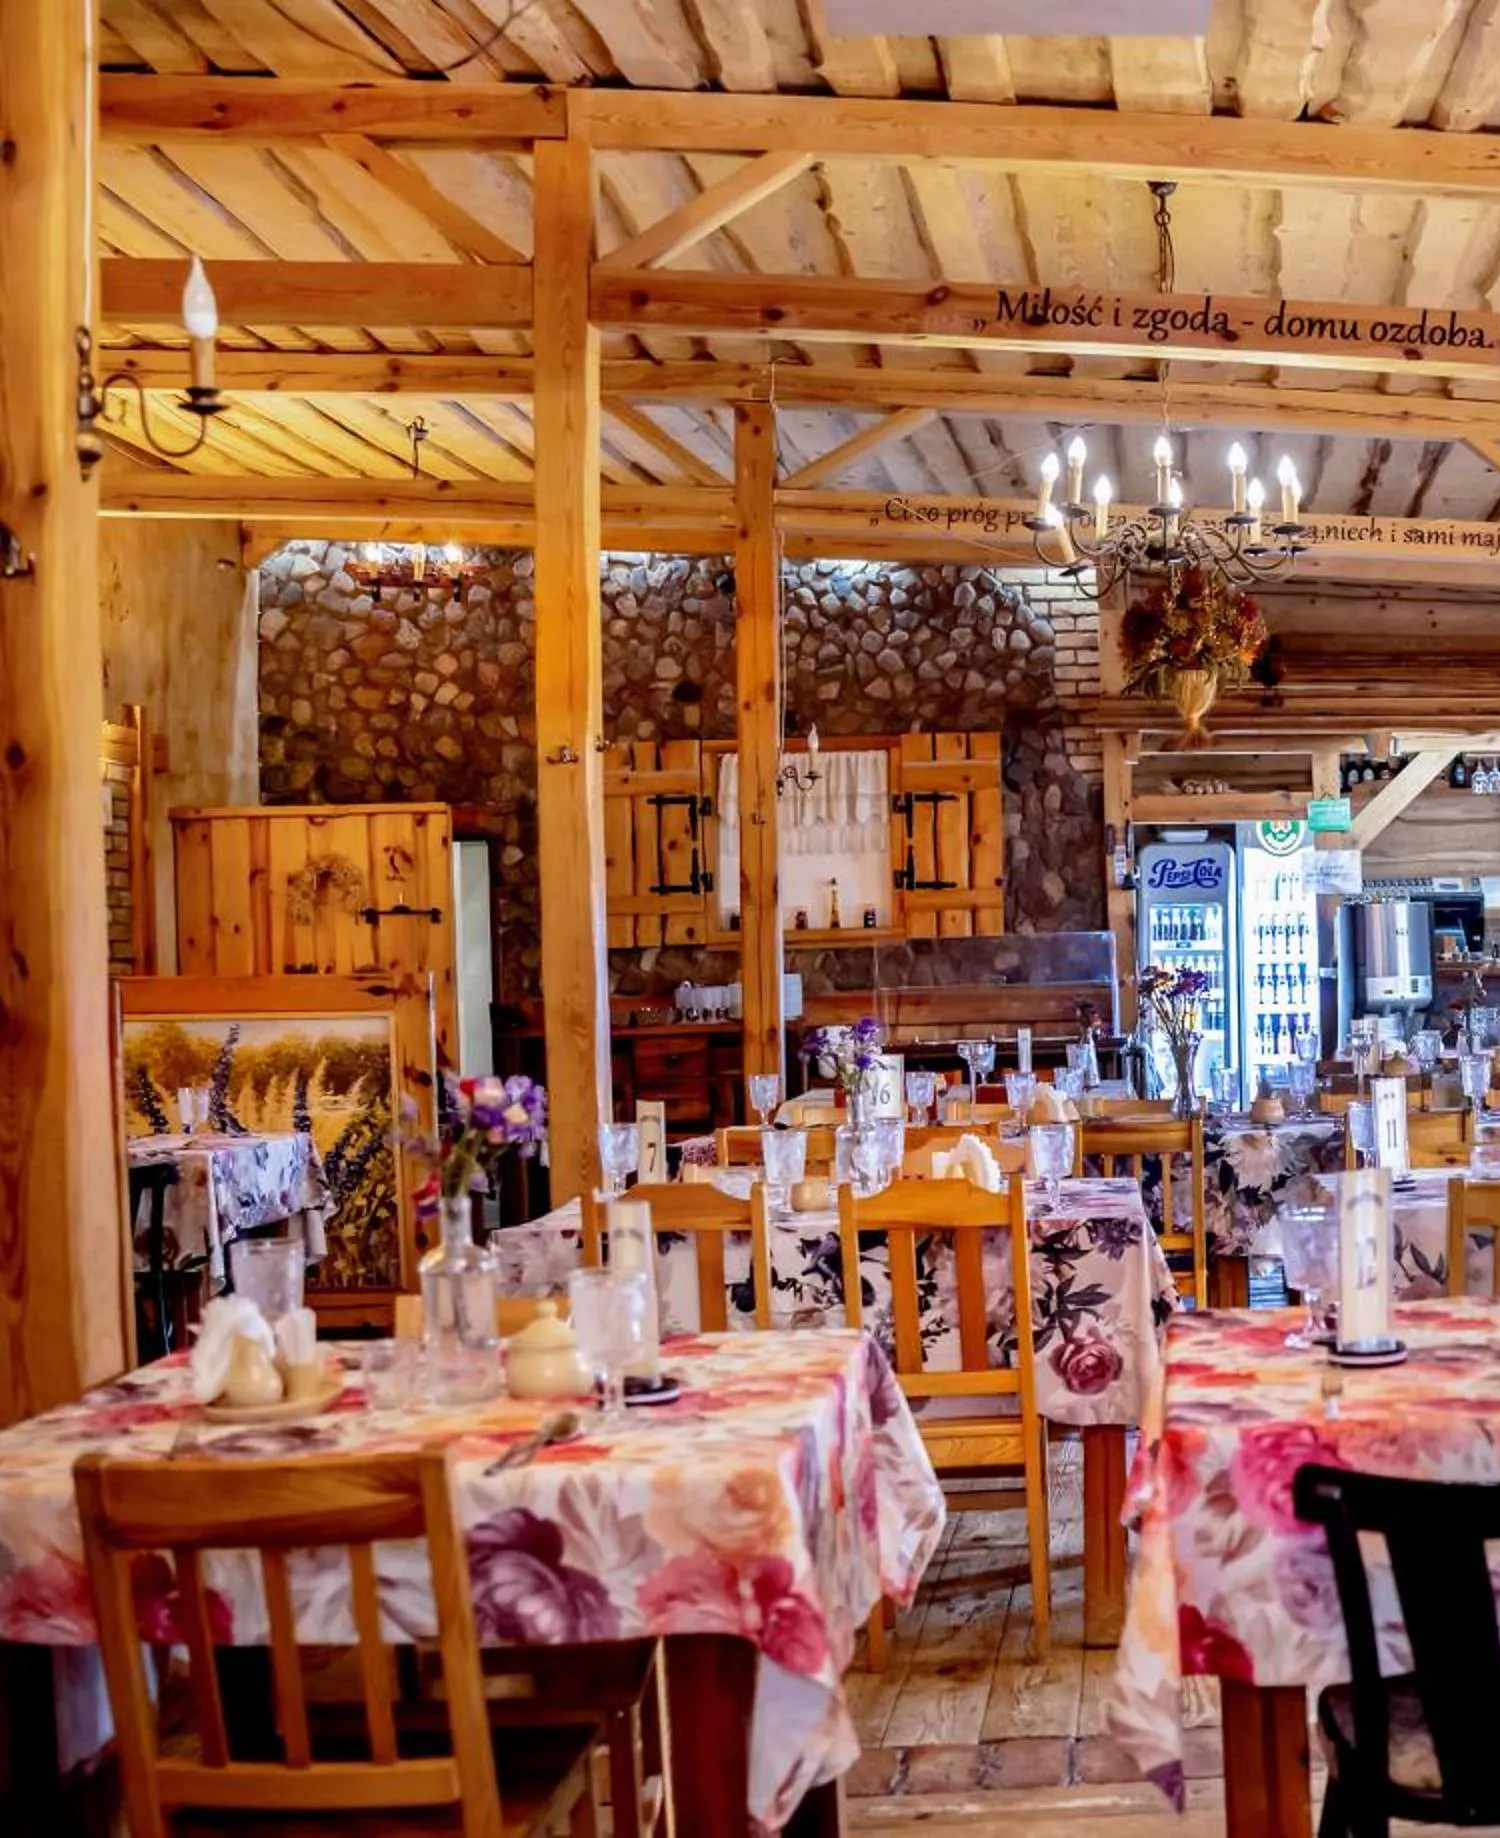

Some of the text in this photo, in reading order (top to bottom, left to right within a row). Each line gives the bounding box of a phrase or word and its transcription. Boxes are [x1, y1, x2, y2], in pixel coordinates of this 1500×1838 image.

[1113, 297, 1122, 327] i
[1132, 295, 1229, 342] zgoda
[1263, 299, 1361, 341] domu
[945, 501, 999, 533] próg
[1390, 521, 1397, 543] i
[1403, 523, 1455, 546] sami
[1386, 1119, 1398, 1149] 11
[647, 1142, 657, 1172] 7
